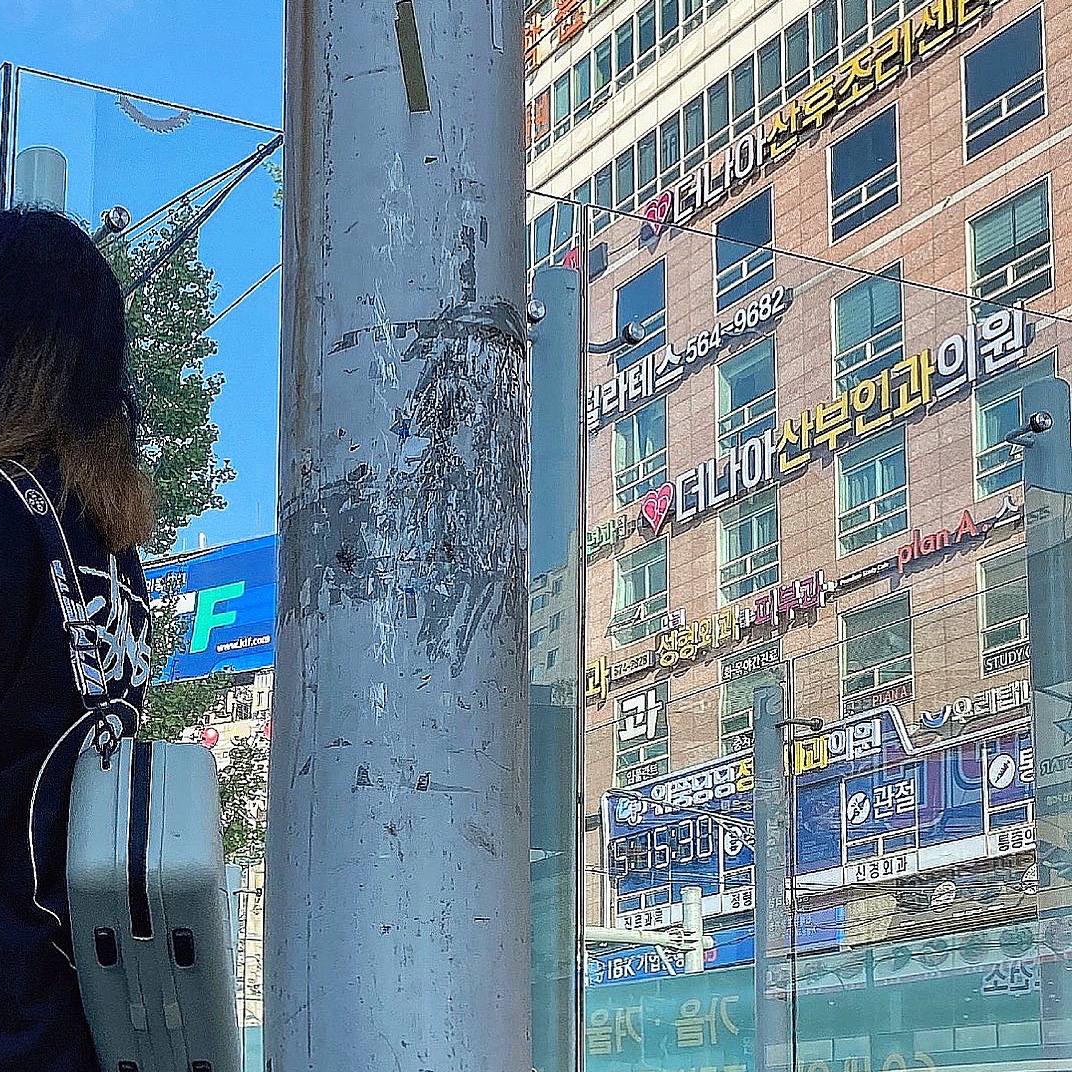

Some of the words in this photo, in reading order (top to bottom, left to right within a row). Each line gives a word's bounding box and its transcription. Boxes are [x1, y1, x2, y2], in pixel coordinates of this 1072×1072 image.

[897, 527, 950, 573] plan
[189, 580, 246, 654] F
[755, 569, 826, 625] 피부과
[872, 777, 917, 820] 관절
[854, 856, 910, 884] 신경외과
